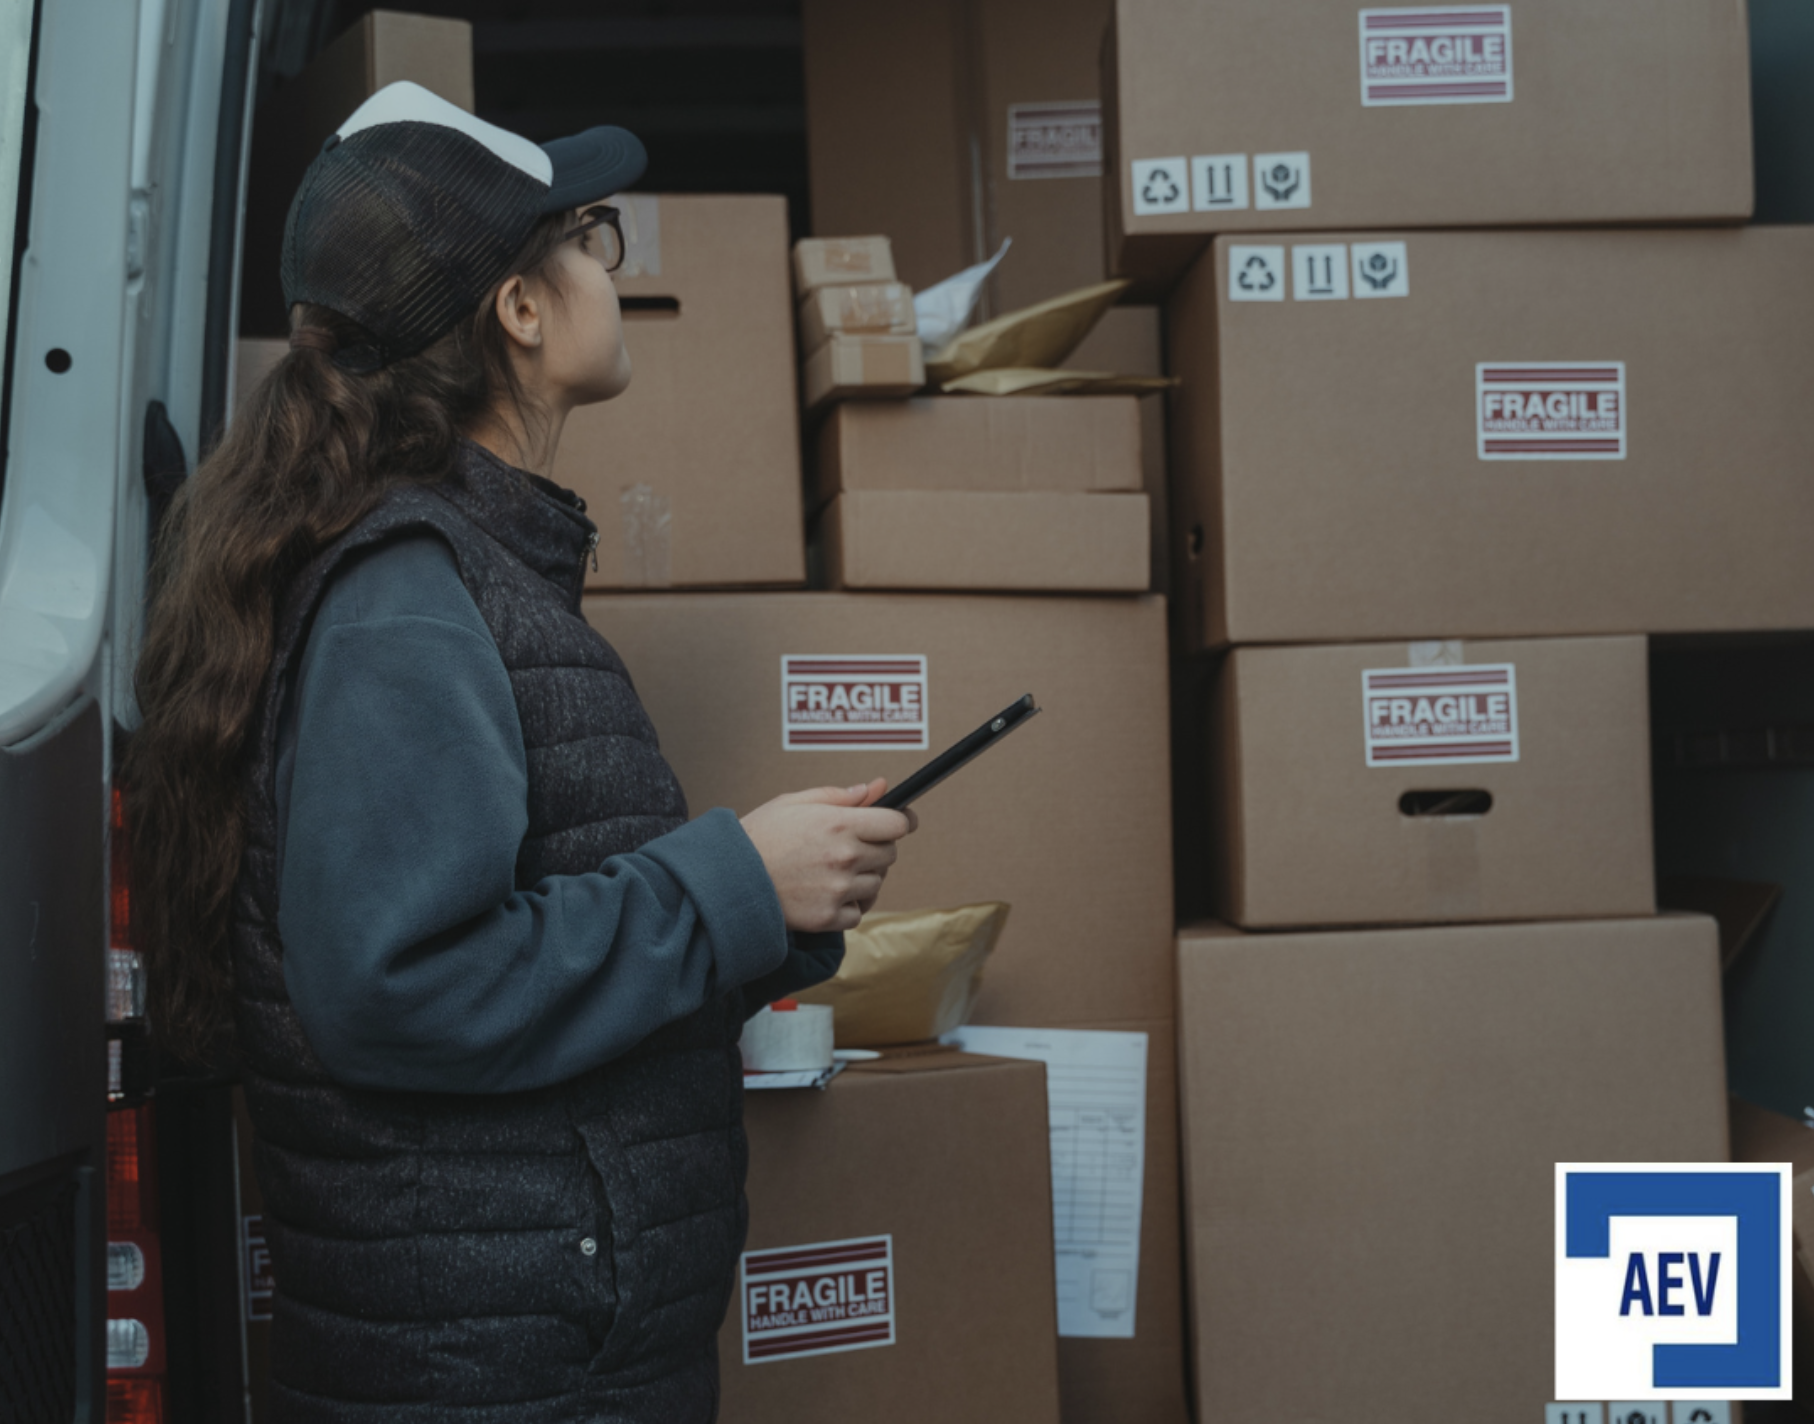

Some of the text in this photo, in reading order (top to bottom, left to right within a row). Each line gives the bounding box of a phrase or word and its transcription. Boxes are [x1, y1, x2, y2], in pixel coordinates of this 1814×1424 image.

[1368, 36, 1504, 65] FRAGILE
[1016, 126, 1100, 149] FRAGIL
[1484, 392, 1618, 419] FRAGILE
[789, 684, 920, 710] FRAGILE
[1371, 694, 1508, 725] FRAGILE
[749, 1270, 886, 1315] FRAGILE
[750, 1300, 886, 1330] HANDLE WITH CARE
